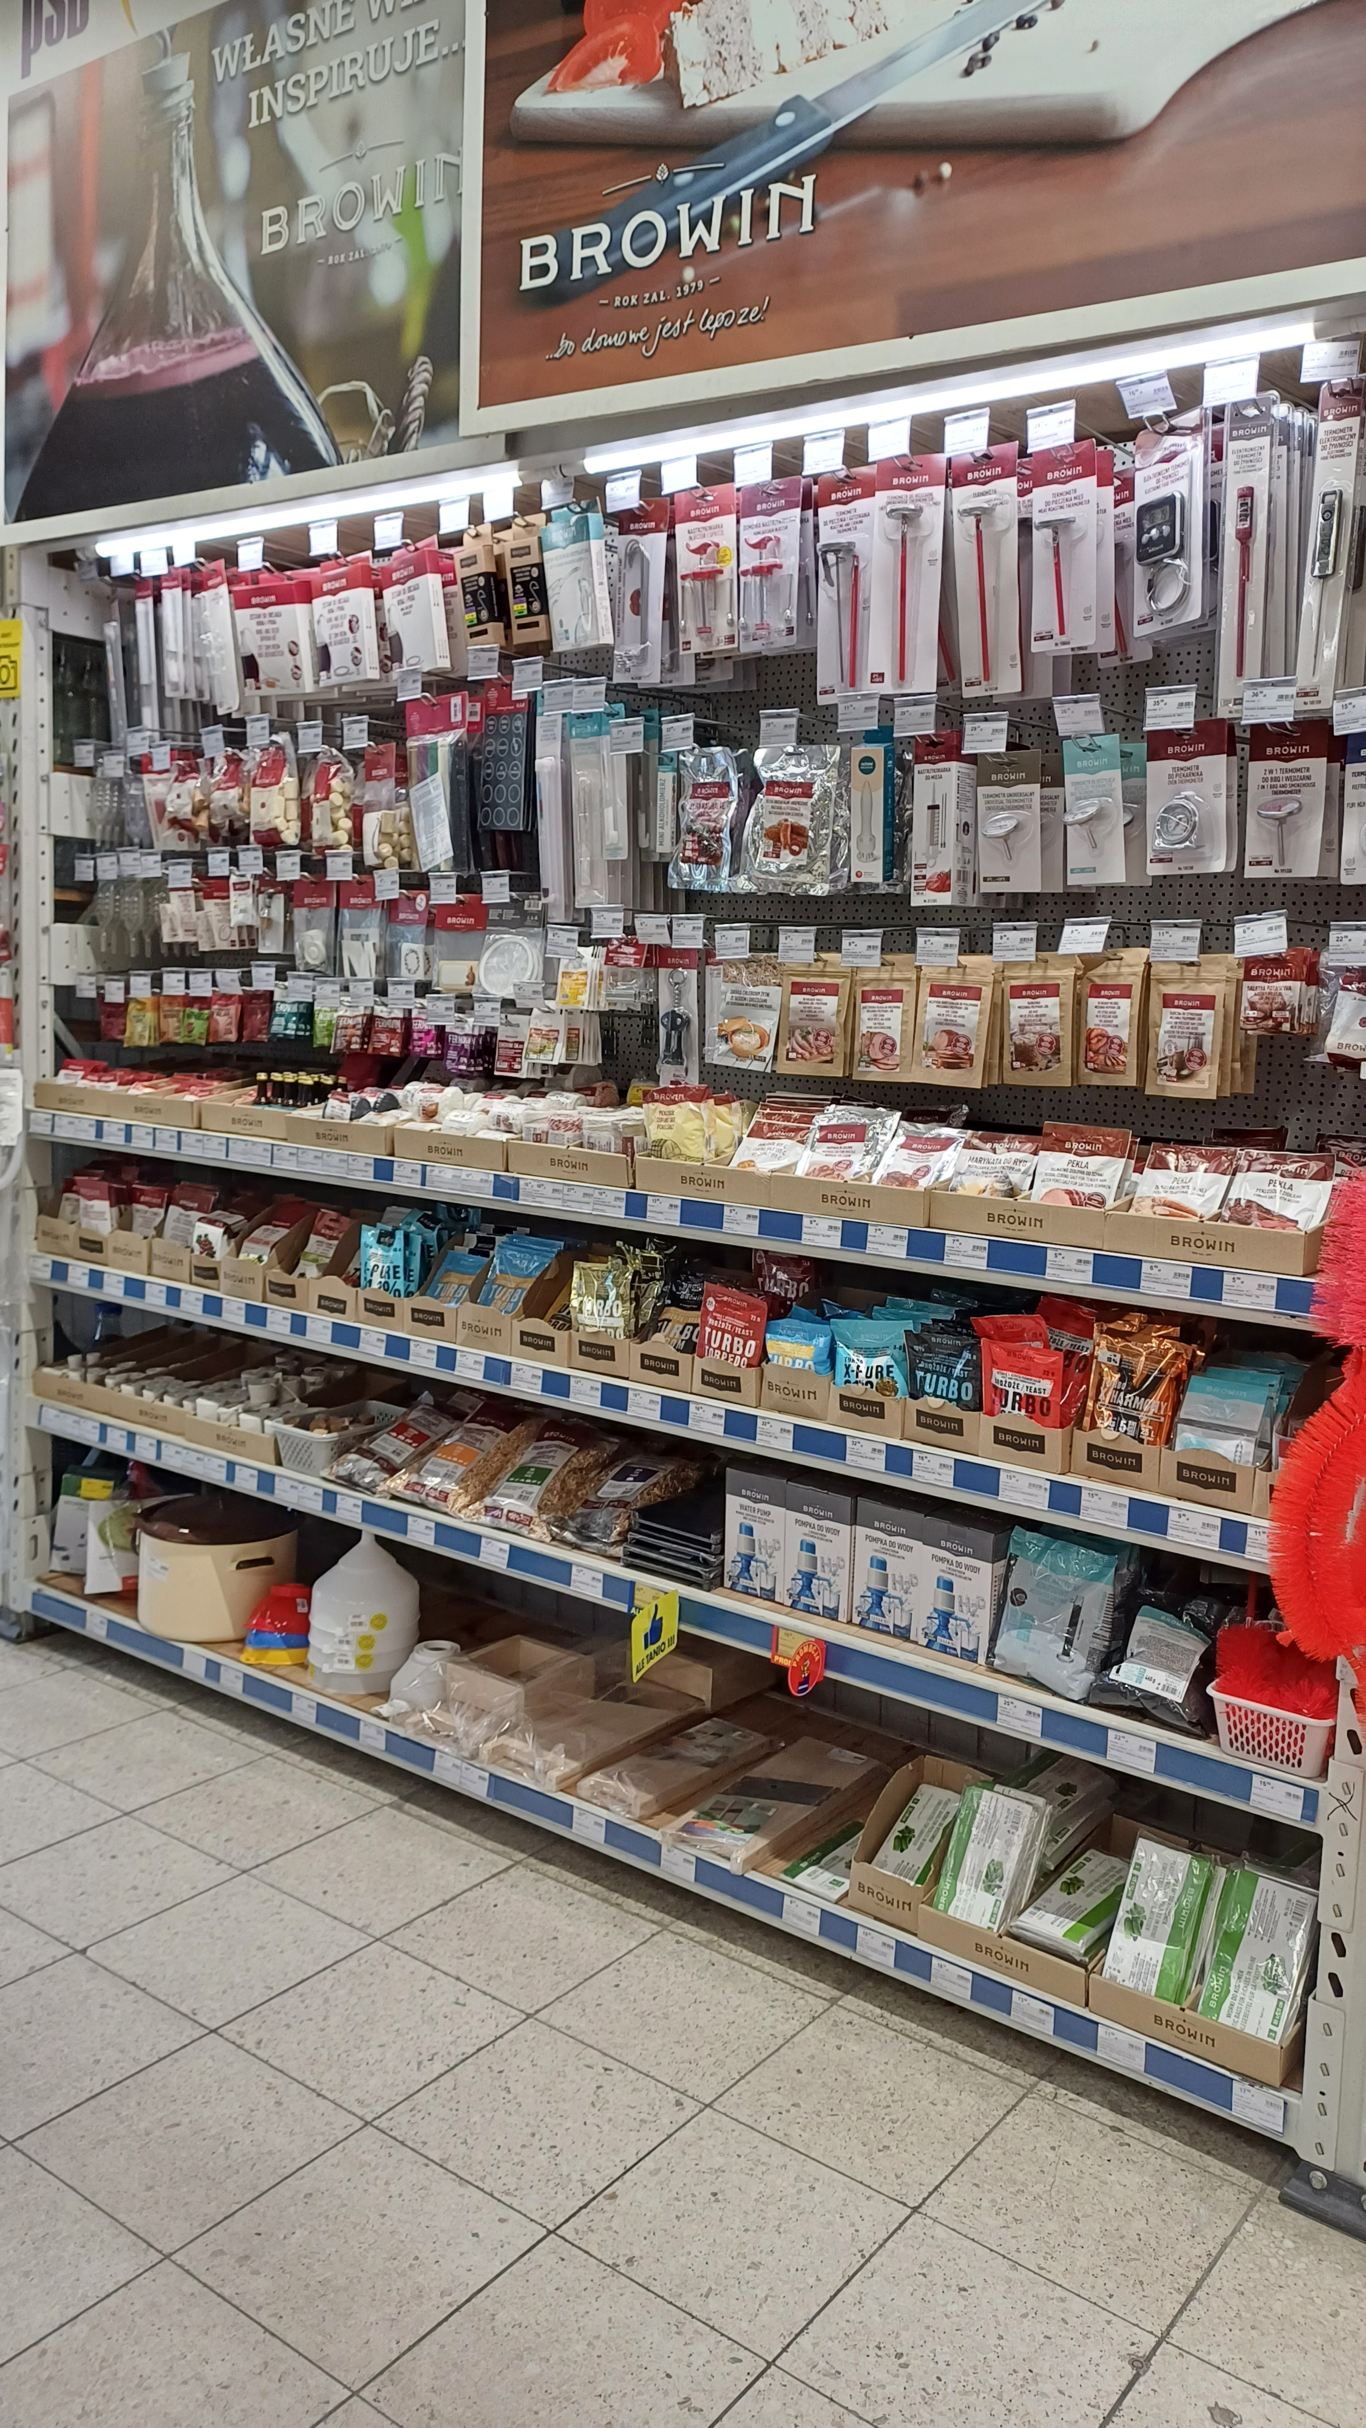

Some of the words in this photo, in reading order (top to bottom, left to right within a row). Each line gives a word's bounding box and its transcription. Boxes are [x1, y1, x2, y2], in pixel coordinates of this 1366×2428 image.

[211, 0, 355, 83] WŁASNE
[248, 18, 465, 129] INSPIRUJE...
[260, 146, 462, 256] BROWIN
[519, 174, 817, 291] BROWIN
[613, 294, 639, 308] ROK
[643, 290, 671, 305] ZAL.
[676, 279, 704, 298] 1979
[581, 327, 649, 353] domowe
[642, 308, 696, 357] jest
[1323, 404, 1358, 417] BROWIN
[1232, 426, 1267, 437] BROWIN
[892, 474, 929, 485] BROWIN
[967, 467, 1002, 480] BROWIN
[1046, 466, 1083, 481] BROWIN
[830, 487, 862, 501] BROWIN
[690, 505, 720, 517] BROWIN
[756, 499, 785, 511] BROWIN
[629, 521, 656, 531] BROWIN
[1167, 743, 1205, 754] BROWIN
[1266, 745, 1310, 755] BROWIN
[1077, 758, 1108, 768] BROWIN
[1171, 764, 1199, 773] TERMOMETR
[990, 772, 1026, 782] BROWIN
[1279, 766, 1310, 775] TERMOMETR
[773, 786, 803, 795] BROWIN
[982, 792, 1005, 800] TERMOMETR
[658, 778, 667, 831] ALKOHOLOMIERZ
[446, 915, 475, 925] BROWIN
[667, 957, 690, 965] BROWIN
[1250, 968, 1291, 977] BROWIN
[802, 986, 826, 994] BROWIN
[1021, 989, 1047, 997] BROWIN
[1100, 989, 1120, 997] BROWIN
[1173, 999, 1201, 1007] BROWIN
[653, 1092, 685, 1101] BROWIN
[134, 1105, 161, 1115] BROWIN
[231, 1117, 263, 1127] BROWIN
[315, 1131, 349, 1142] BROWIN
[427, 1145, 463, 1157] BROWIN
[911, 1143, 941, 1151] BROWIN
[986, 1140, 1021, 1150] BROWIN
[1065, 1141, 1103, 1151] BROWIN
[550, 1157, 589, 1171] BROWIN
[967, 1155, 1001, 1167] MARYNATA
[1066, 1159, 1090, 1170] PEKLA
[1265, 1163, 1308, 1176] BROWIN
[680, 1175, 725, 1190] BROWIN
[1267, 1178, 1294, 1191] PEKLA
[821, 1193, 871, 1209] BROWIN
[987, 1212, 1044, 1229] BROWIN
[1170, 1235, 1236, 1253] BROWIN
[366, 1302, 392, 1313] BROWIN
[722, 1295, 748, 1309] BROWIN
[413, 1312, 442, 1322] BROWIN
[461, 1321, 502, 1337] BROWIN
[523, 1335, 552, 1347] BROWIN
[704, 1327, 756, 1358] TURBO
[931, 1336, 961, 1347] BROWIN
[581, 1345, 611, 1357] BROWIN
[705, 1346, 748, 1369] TORPEDO
[1006, 1351, 1036, 1362] BROWIN
[644, 1358, 676, 1371] BROWIN
[704, 1374, 737, 1388] BROWIN
[914, 1370, 974, 1401] TURBO
[767, 1382, 817, 1400] BROWIN
[1026, 1384, 1047, 1395] YEAST
[1206, 1386, 1247, 1397] BROWIN
[842, 1400, 880, 1413] BROWIN
[920, 1415, 959, 1430] BROWIN
[216, 1433, 246, 1447] BROWIN
[998, 1432, 1040, 1448] BROWIN
[1092, 1449, 1136, 1466] BROWIN
[1182, 1468, 1230, 1486] BROWIN
[741, 1488, 770, 1502] BROWIN
[739, 1503, 755, 1514] WATER
[756, 1507, 771, 1518] PUMP
[803, 1505, 833, 1519] BROWIN
[794, 1518, 816, 1530] POMPKA
[816, 1523, 825, 1531] DO
[825, 1525, 841, 1537] WODY
[874, 1520, 906, 1535] BROWIN
[864, 1534, 888, 1547] POMPKA
[888, 1539, 897, 1548] DO
[897, 1541, 914, 1554] WODY
[940, 1539, 974, 1555] BROWIN
[931, 1553, 955, 1567] POMPKA
[955, 1559, 964, 1568] DO
[964, 1561, 981, 1575] WODY
[635, 1660, 645, 1676] ALE
[645, 1641, 666, 1665] TANIO
[792, 1643, 820, 1667] PROMOCJA
[857, 1881, 913, 1912] BROWIN
[937, 1869, 955, 1911] BROWIN
[1177, 1886, 1196, 1930] BROWIN
[974, 1942, 1030, 1973] BROWIN
[1209, 1964, 1228, 2009] BROWIN
[1153, 2014, 1216, 2048] BROWIN
